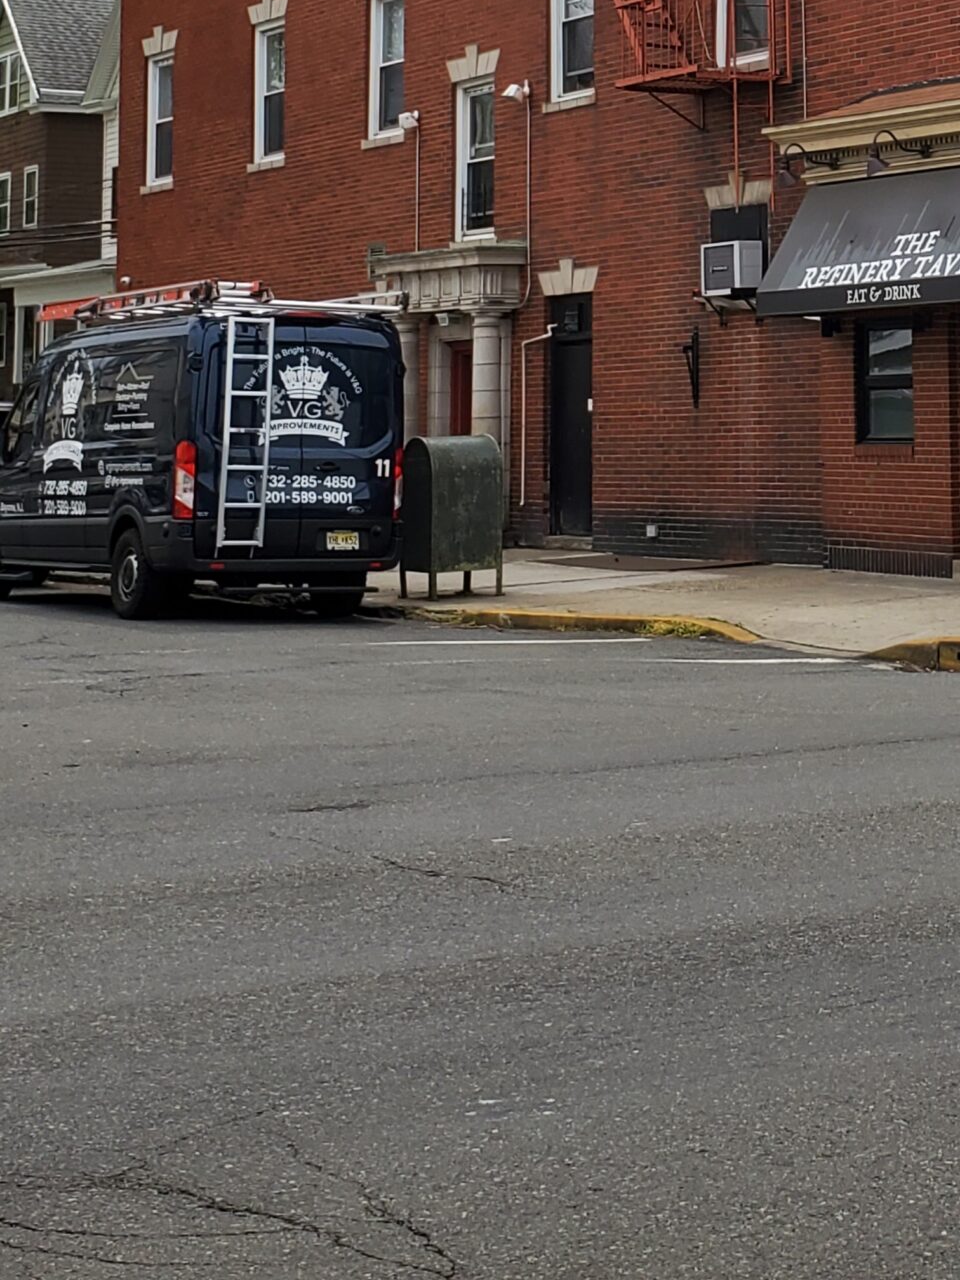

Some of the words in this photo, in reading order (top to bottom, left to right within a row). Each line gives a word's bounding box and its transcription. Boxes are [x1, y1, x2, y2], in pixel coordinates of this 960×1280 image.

[890, 230, 941, 256] THE
[798, 257, 912, 289] REFINERY
[846, 288, 868, 304] EAT
[869, 286, 882, 301] &
[883, 283, 921, 300] DRINK
[311, 346, 325, 357] The
[325, 352, 348, 372] Future
[286, 400, 322, 418] VG
[61, 417, 76, 439] VG
[267, 421, 340, 434] MPROVEMENTS
[375, 458, 391, 478] 11
[260, 474, 356, 489] 32-285-4850
[264, 491, 353, 505] 201-589-9001
